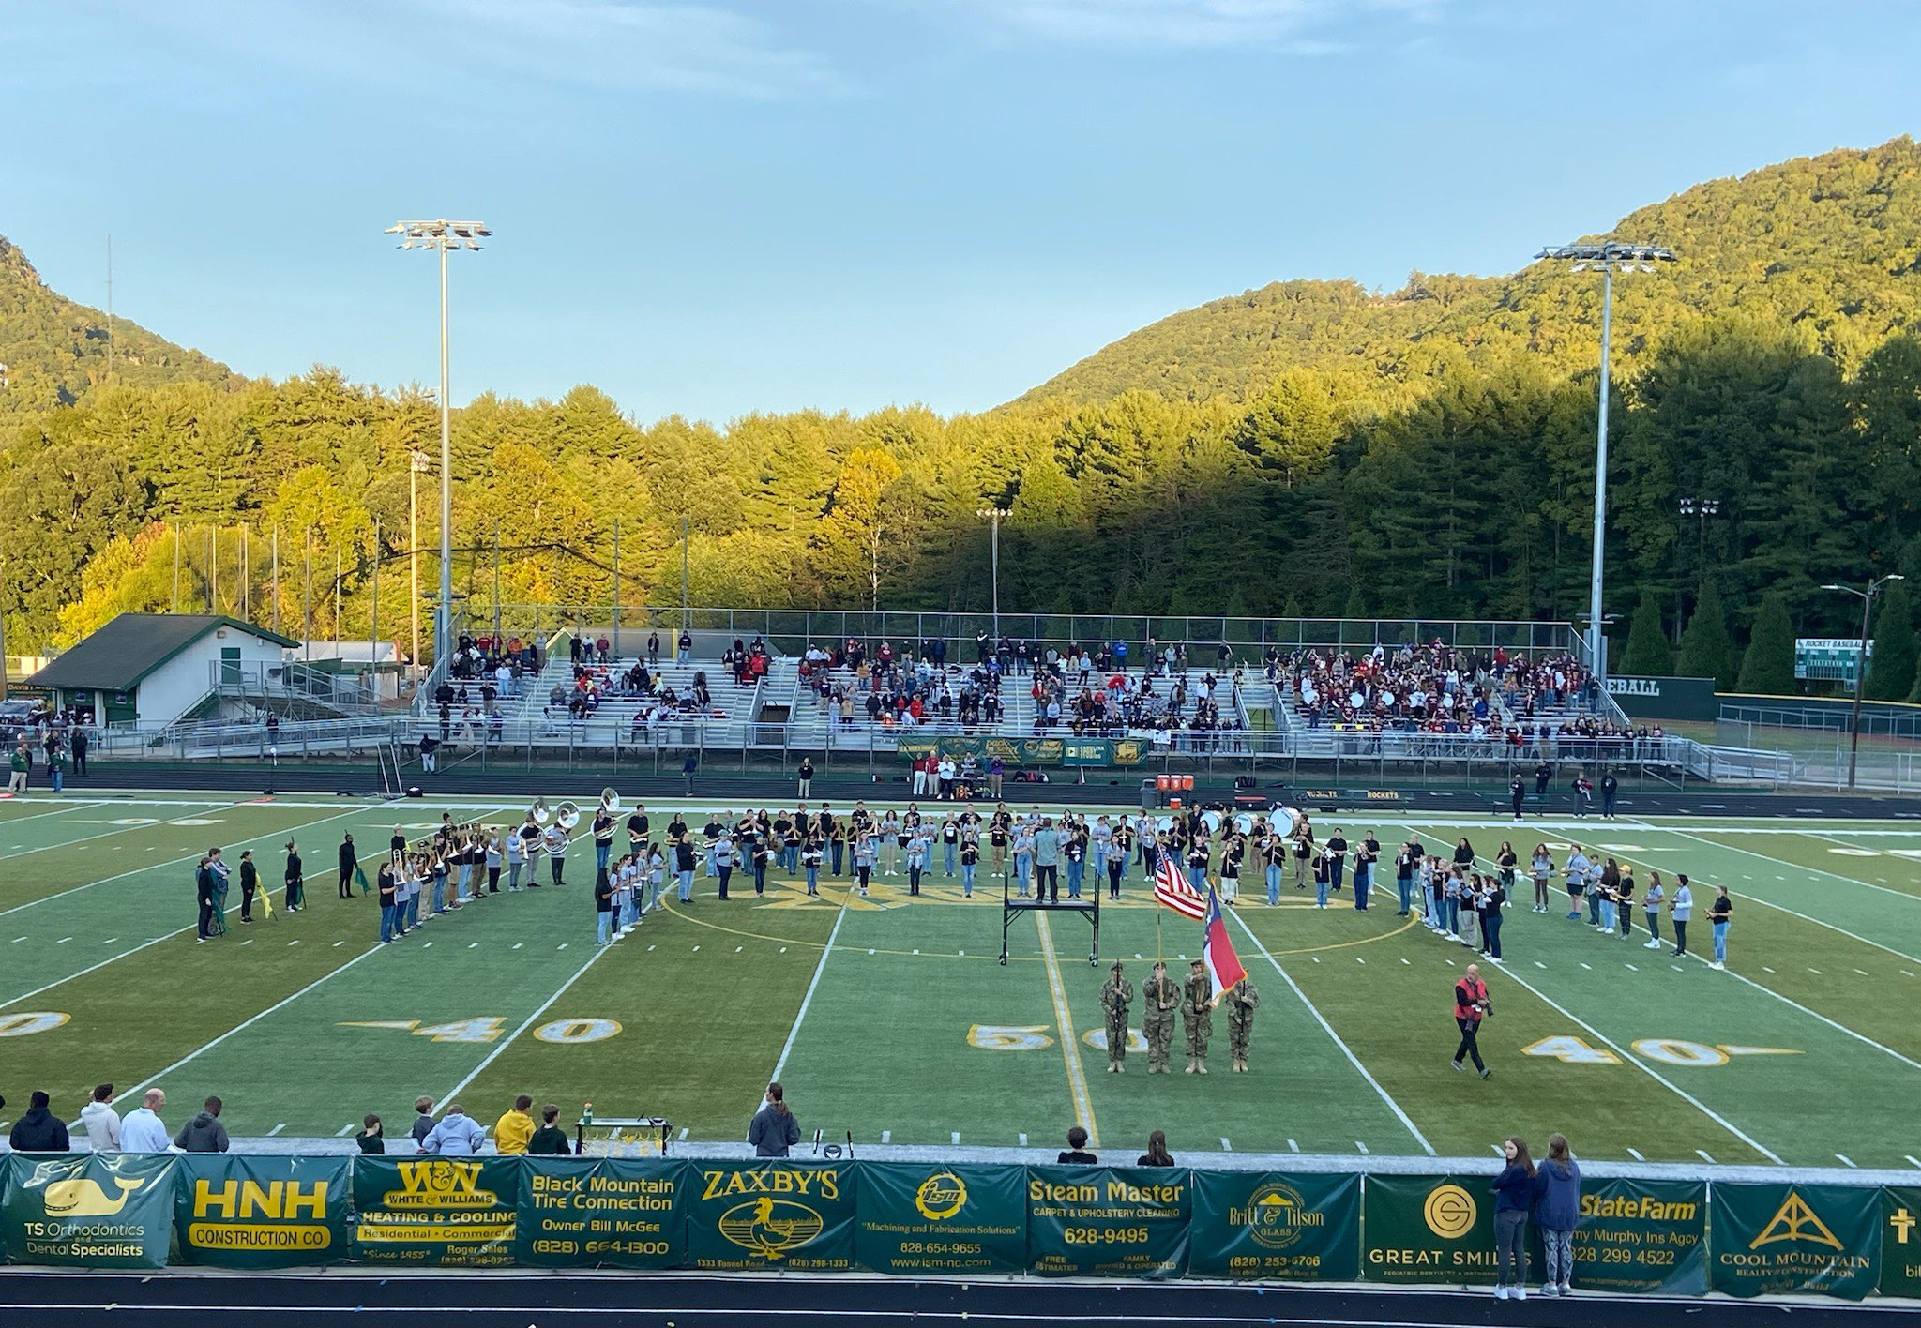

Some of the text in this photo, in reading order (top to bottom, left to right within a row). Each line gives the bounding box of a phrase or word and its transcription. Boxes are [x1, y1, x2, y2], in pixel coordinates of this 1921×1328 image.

[532, 1175, 674, 1194] Black Mountain
[702, 1170, 839, 1200] ZAXBY'S
[1030, 1180, 1184, 1203] Steam Master
[194, 1179, 329, 1219] HNH
[388, 1195, 424, 1204] WHITE
[439, 1194, 493, 1204] WILLIAMS
[533, 1193, 672, 1210] Tire Connection
[363, 1212, 518, 1223] HEATING & COOLING
[1033, 1207, 1180, 1218] CARPET & UPHOLSTERY CLEANING
[1263, 1206, 1281, 1226] &
[1284, 1206, 1325, 1227] Tilson
[24, 1222, 145, 1237] TS Orthodontics
[363, 1229, 515, 1238] Residential Commercial
[542, 1219, 660, 1232] Owner Bill McGee
[913, 1225, 928, 1233] and
[977, 1226, 1021, 1235] Solutions"
[196, 1229, 324, 1245] CONSTRUCTION CO
[1064, 1227, 1149, 1244] 628-9495
[1594, 1229, 1642, 1246] Murphy
[1646, 1231, 1665, 1244] Ins
[1668, 1232, 1698, 1246] Agcy
[26, 1242, 144, 1258] Dental Specialists
[447, 1244, 478, 1255] Roger
[533, 1240, 579, 1255] (828)
[1369, 1248, 1443, 1265] GREAT
[1602, 1248, 1632, 1263] 299
[1636, 1250, 1674, 1265] 4522
[1720, 1252, 1870, 1269] COOL MOUNTAIN
